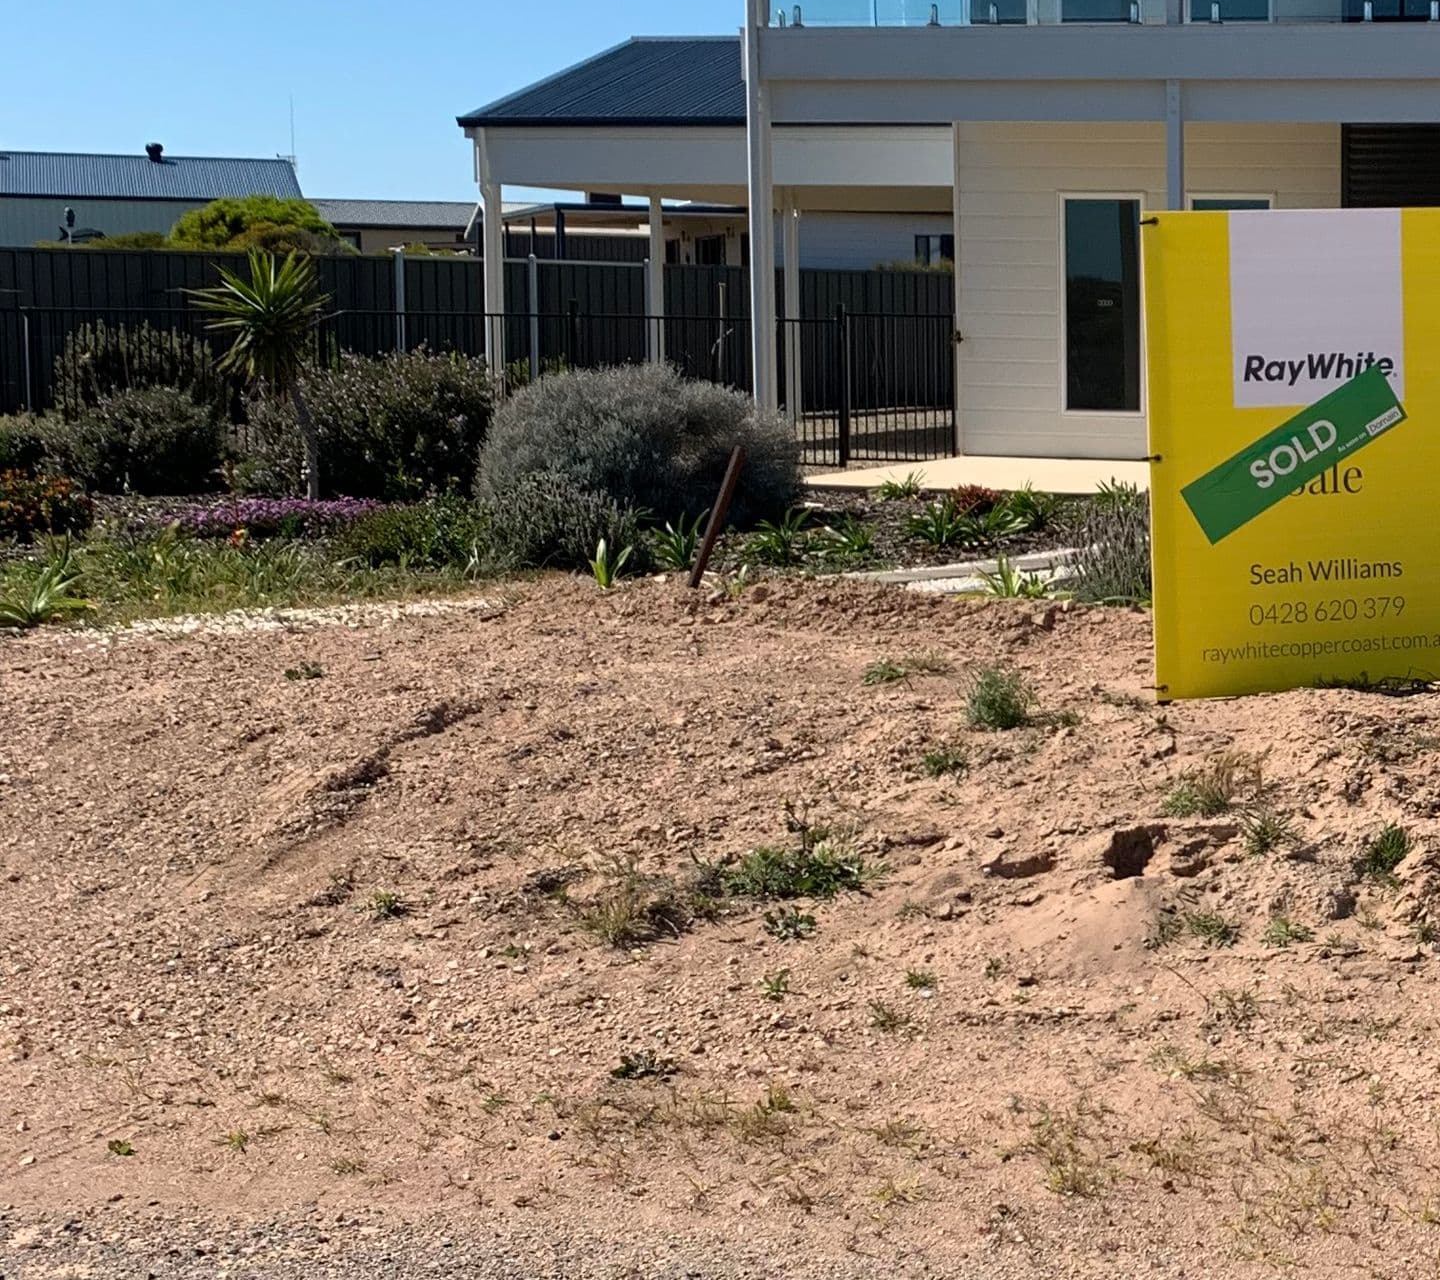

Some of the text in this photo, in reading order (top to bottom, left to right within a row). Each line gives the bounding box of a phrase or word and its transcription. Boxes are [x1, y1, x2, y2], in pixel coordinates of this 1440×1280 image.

[1368, 410, 1400, 434] Domain
[1249, 419, 1338, 489] SOLD
[1249, 558, 1404, 586] Seah Williams
[1249, 595, 1406, 626] 0428 620 379
